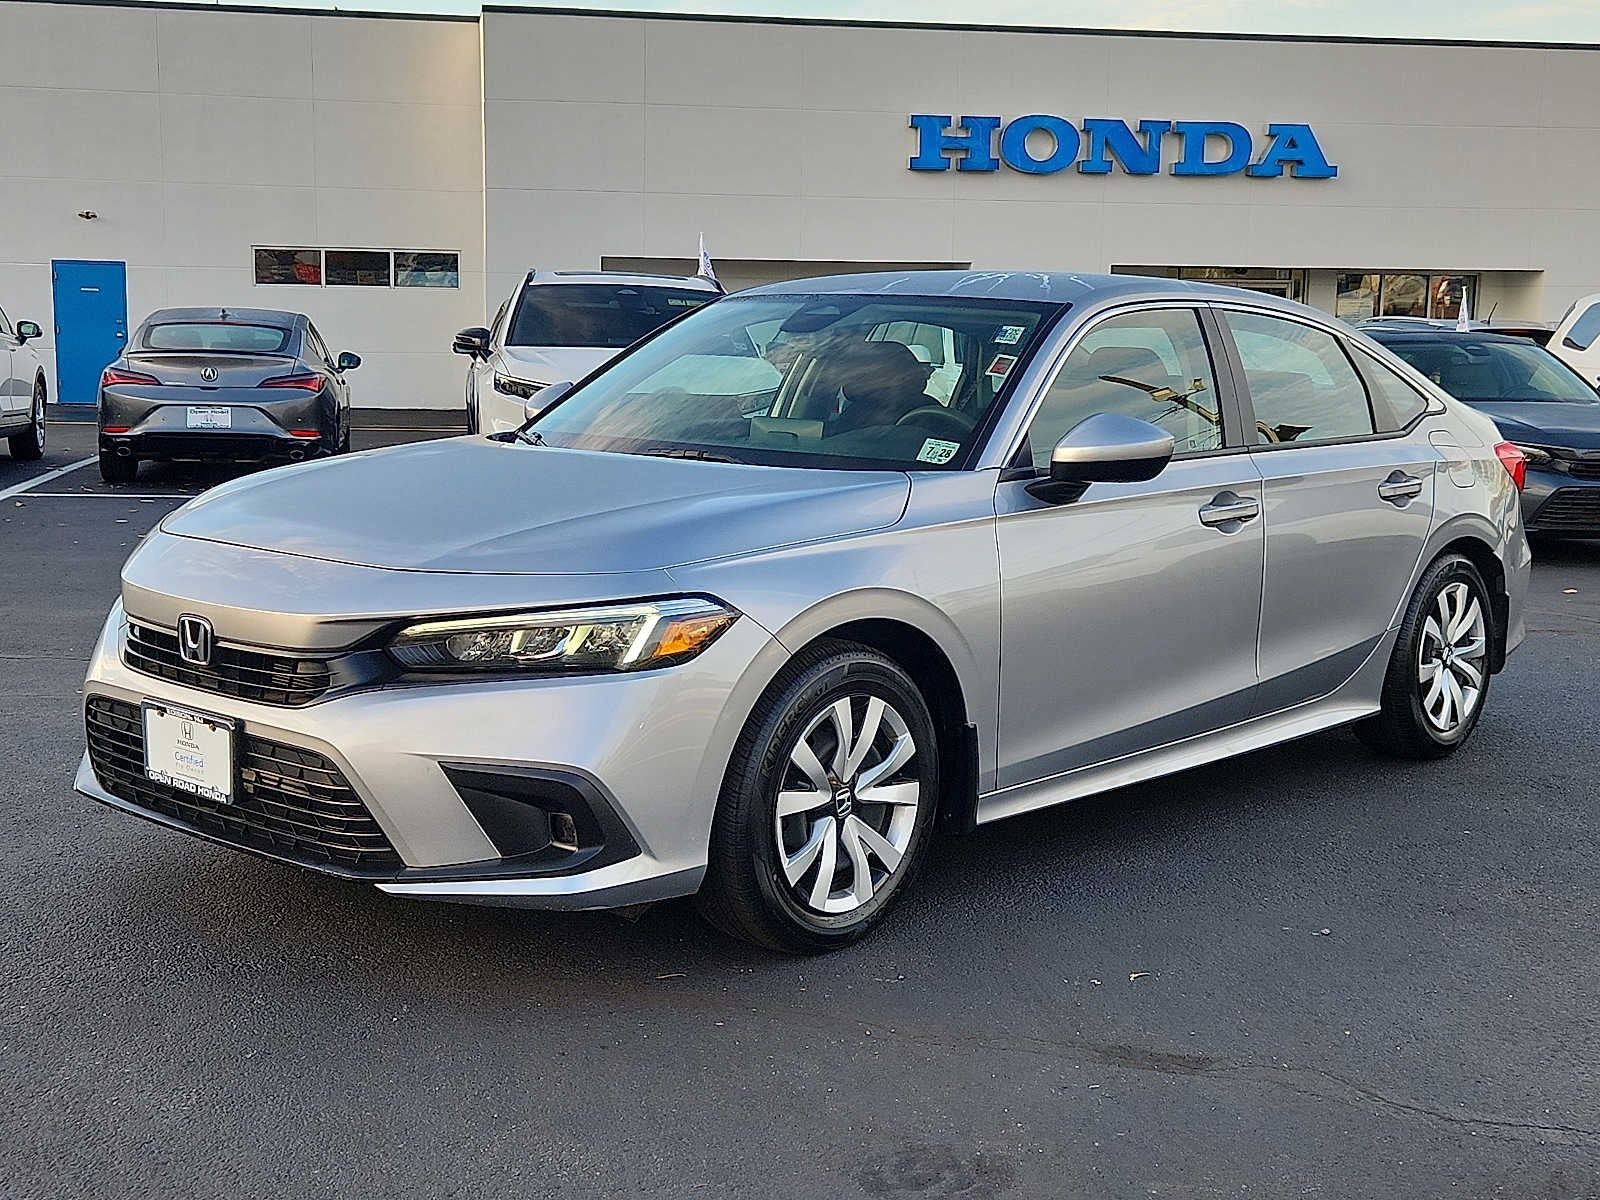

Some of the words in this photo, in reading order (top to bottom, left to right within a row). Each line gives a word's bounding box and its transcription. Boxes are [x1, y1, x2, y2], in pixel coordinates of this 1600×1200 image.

[908, 113, 1338, 179] HONDA
[926, 446, 935, 455] 7
[938, 448, 953, 459] 28
[176, 739, 200, 750] HONDA
[174, 751, 204, 768] Certified
[148, 770, 172, 785] OPEN
[172, 776, 197, 793] ROAD
[197, 785, 227, 803] HONDA
